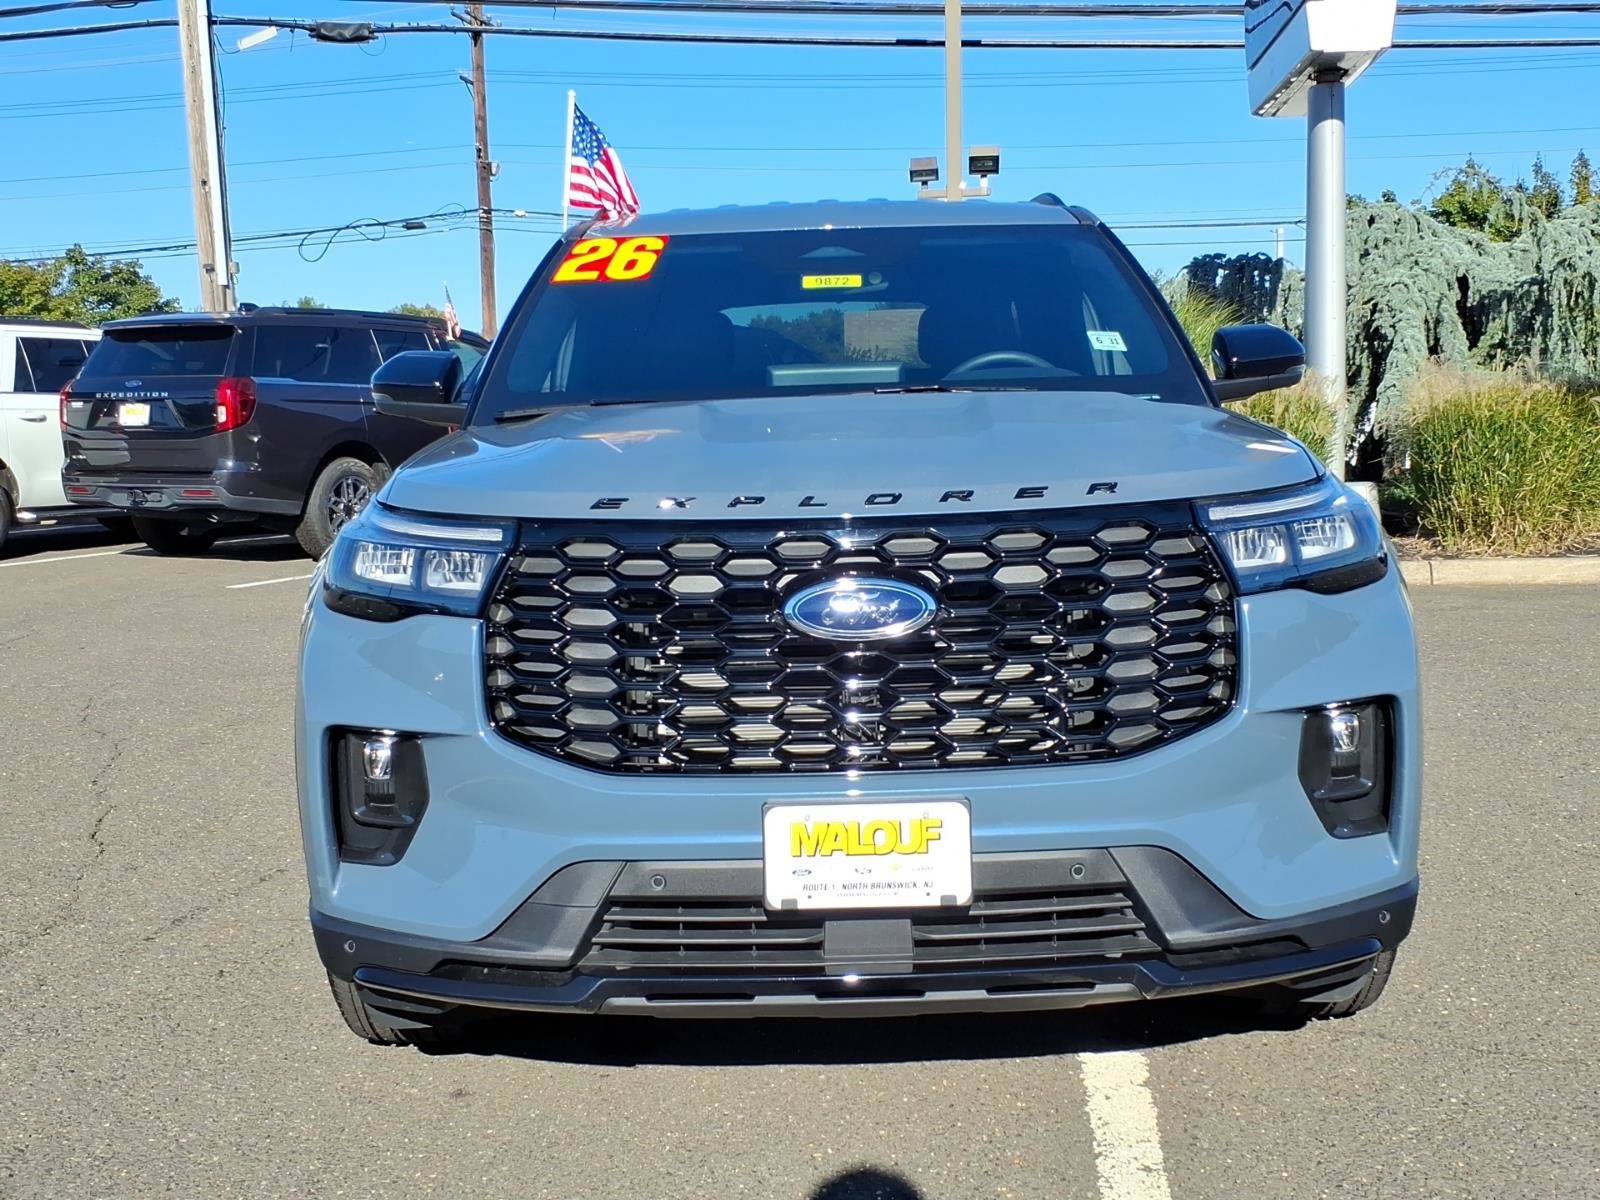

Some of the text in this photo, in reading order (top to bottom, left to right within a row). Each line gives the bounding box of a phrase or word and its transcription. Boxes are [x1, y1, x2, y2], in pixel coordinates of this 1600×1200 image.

[553, 236, 665, 282] 26
[815, 277, 850, 286] 9872
[96, 391, 169, 399] EXPEDITION
[589, 481, 1118, 510] EXPLORER
[790, 819, 942, 857] MALOUF
[803, 882, 828, 891] ROUTE
[841, 881, 868, 890] NORTH
[923, 880, 934, 888] NJ
